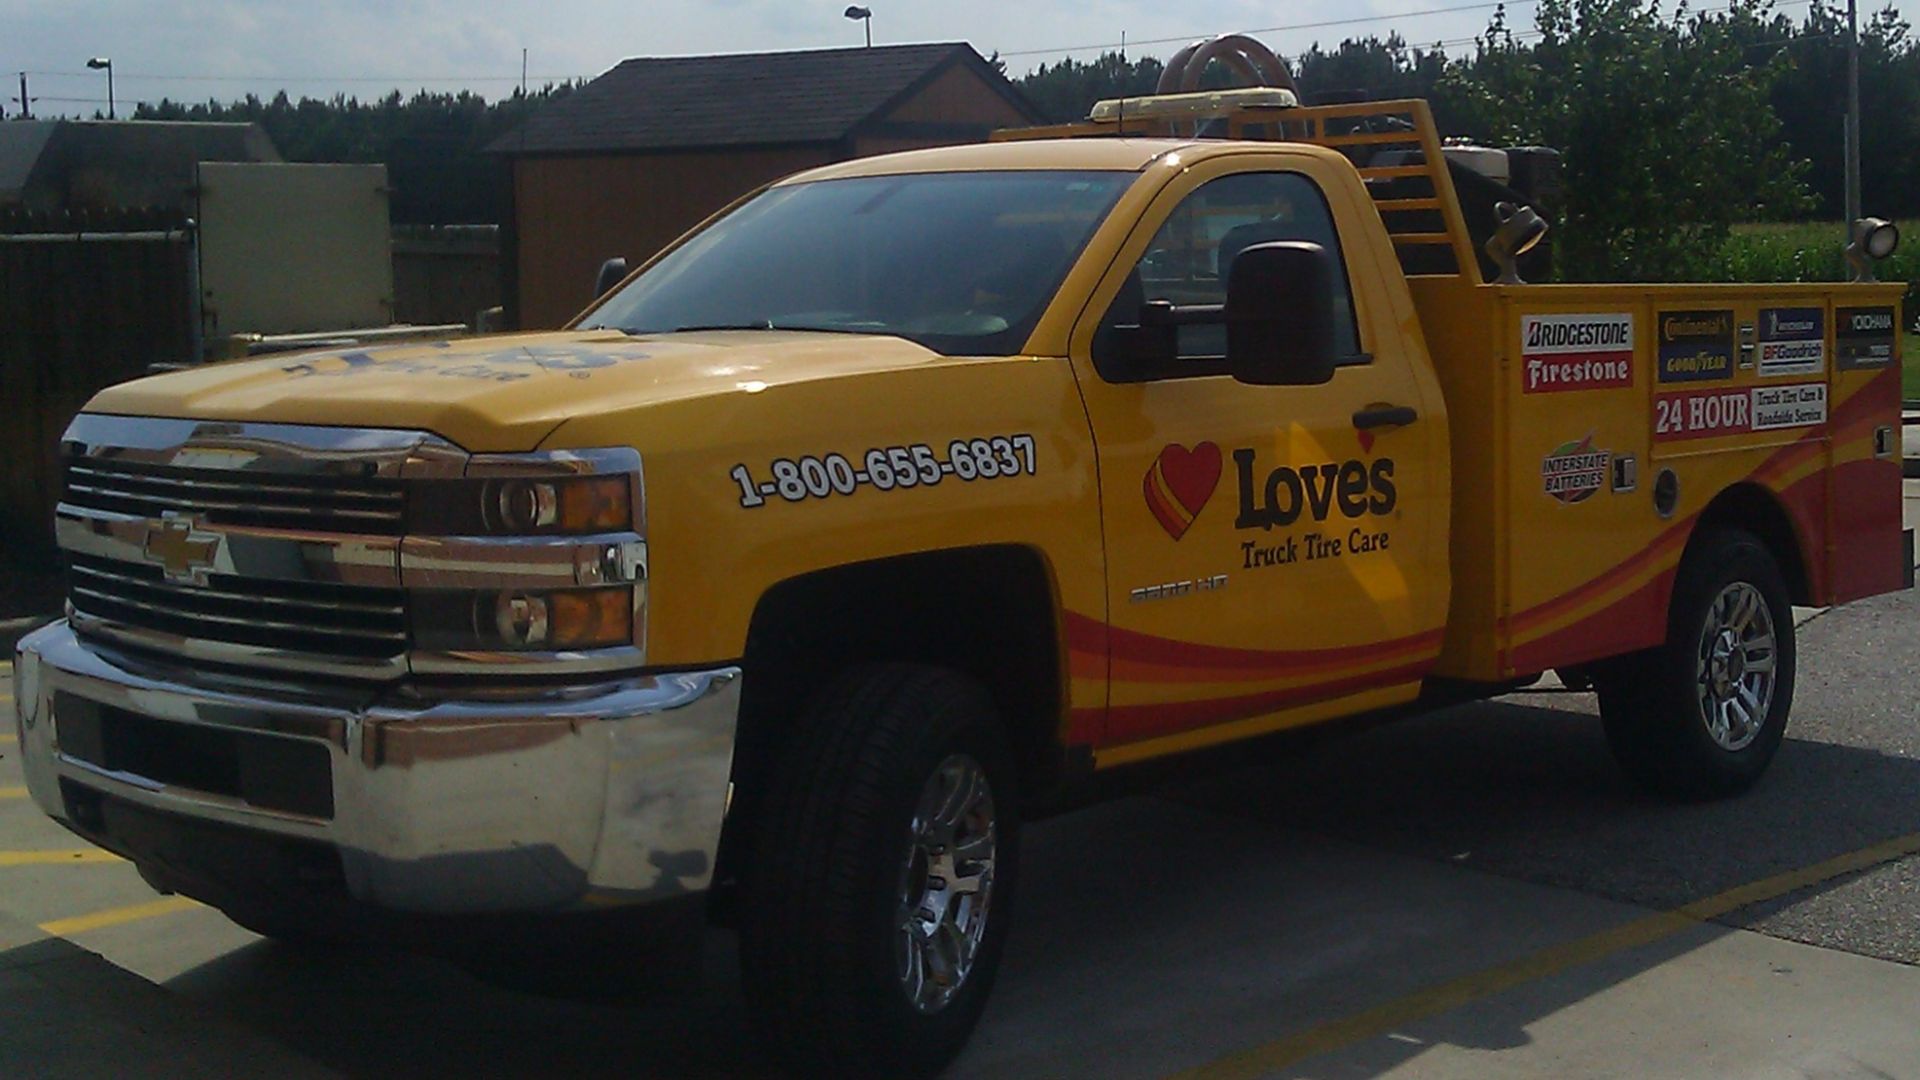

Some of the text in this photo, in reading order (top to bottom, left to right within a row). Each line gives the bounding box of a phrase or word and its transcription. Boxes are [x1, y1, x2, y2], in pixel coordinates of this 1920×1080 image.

[1527, 321, 1629, 347] BRIDGESTONE
[1528, 360, 1628, 389] Firestone
[1757, 391, 1780, 406] Truck
[1656, 394, 1749, 433] 24 HOUR
[730, 434, 1036, 508] 1-800-655-6837
[1544, 453, 1609, 474] INTERSTATE
[1545, 472, 1604, 492] BATTERIES
[1241, 528, 1389, 569] Truck Tire Care
